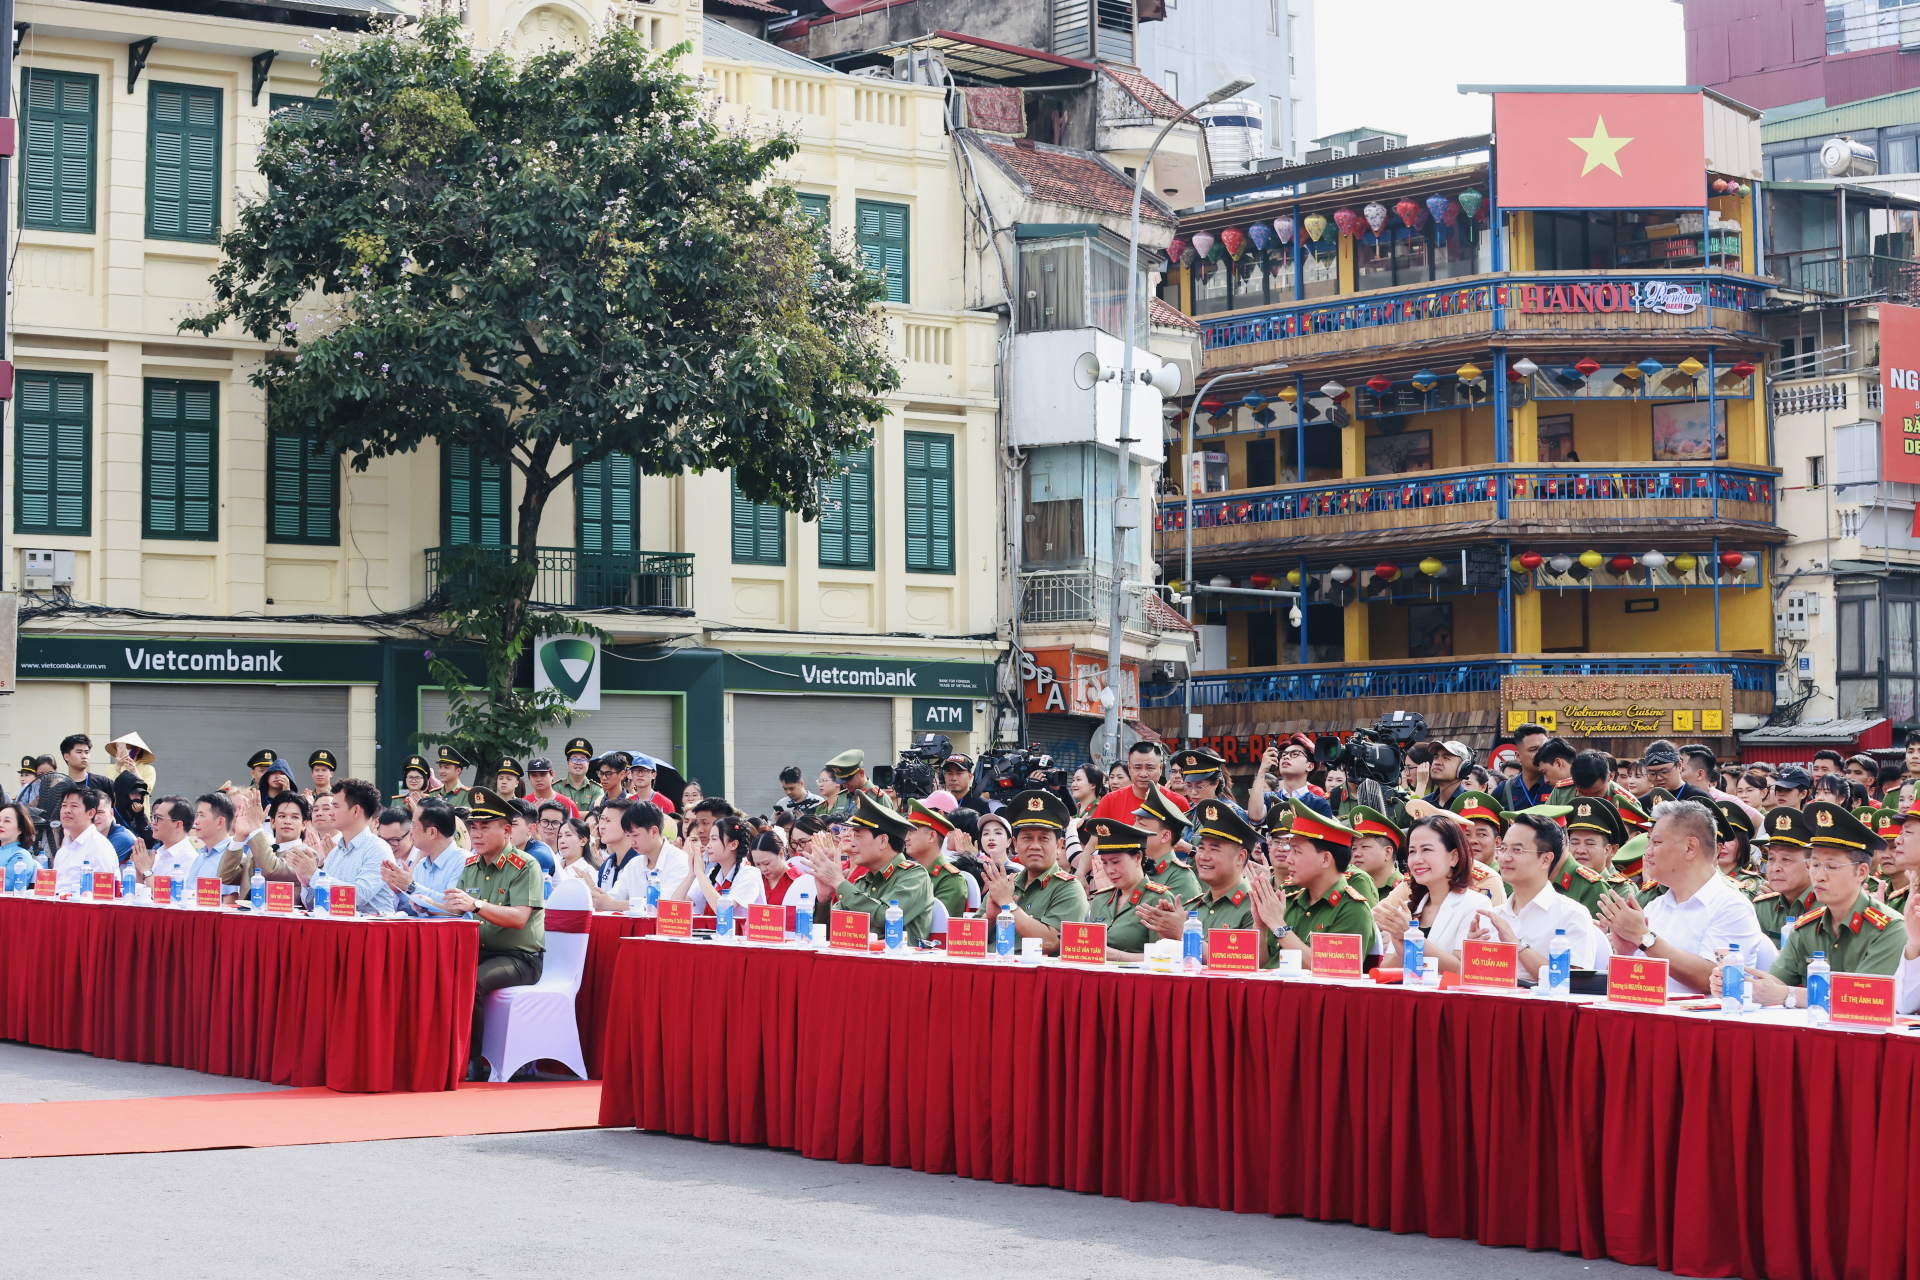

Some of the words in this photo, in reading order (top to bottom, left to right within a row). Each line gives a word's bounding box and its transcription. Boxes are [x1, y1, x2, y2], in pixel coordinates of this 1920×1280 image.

[1520, 283, 1632, 314] HANOI
[1645, 281, 1702, 309] Premium
[125, 647, 283, 672] Vietcombank
[801, 664, 917, 687] Vietcombank
[1022, 652, 1067, 711] SPA
[1505, 680, 1555, 700] HANOI
[1558, 680, 1619, 702] SQUARE
[1625, 680, 1725, 700] RESTAURANT
[926, 706, 962, 723] ATM
[1563, 705, 1622, 718] Vietnamese
[1626, 704, 1666, 718] Cuisine
[1571, 719, 1628, 737] Vegetarian
[1630, 719, 1660, 733] Food
[1481, 958, 1495, 967] TUẤN
[1841, 994, 1848, 1003] LÊ
[1848, 996, 1858, 1004] THỊ
[1859, 995, 1871, 1004] ÁNH
